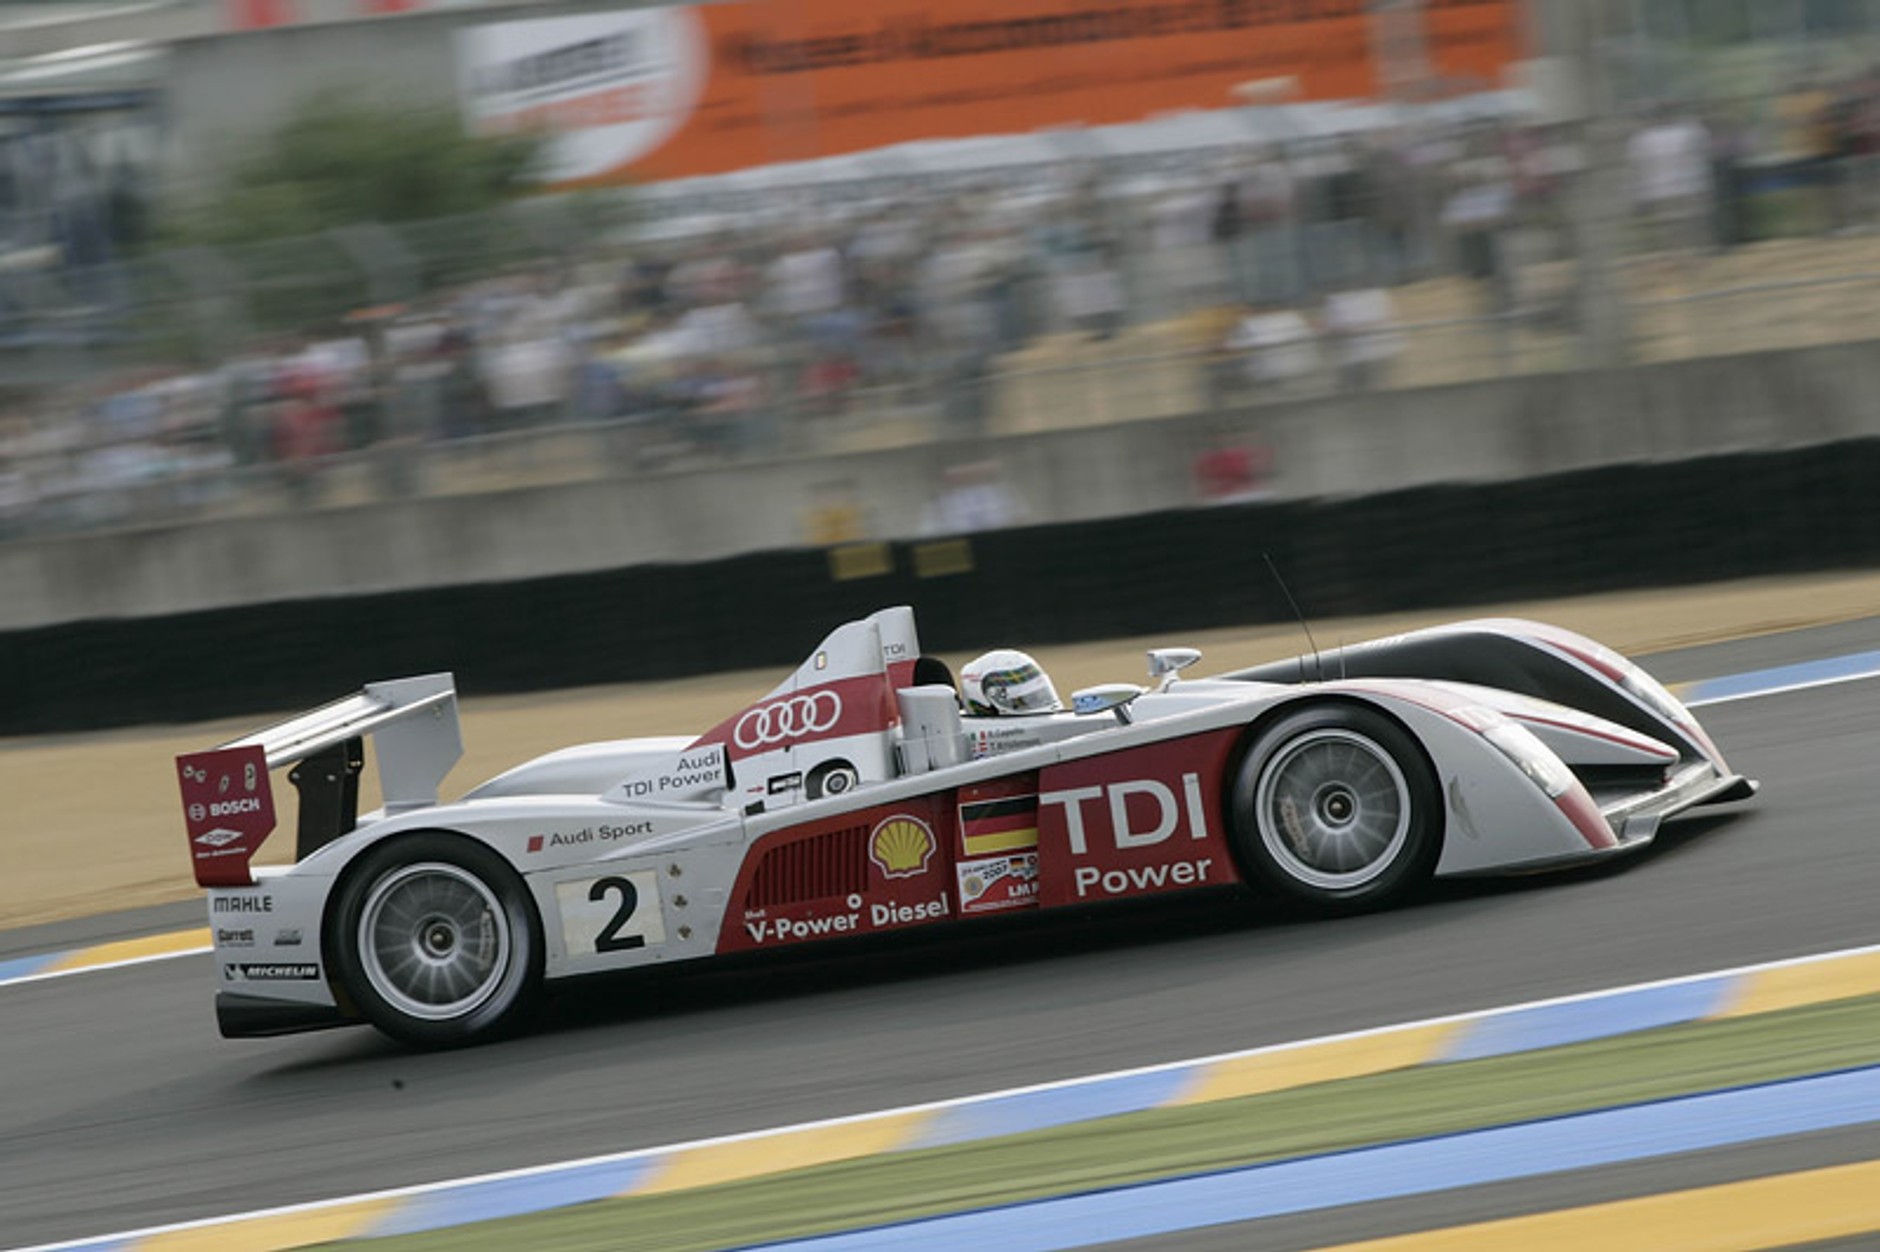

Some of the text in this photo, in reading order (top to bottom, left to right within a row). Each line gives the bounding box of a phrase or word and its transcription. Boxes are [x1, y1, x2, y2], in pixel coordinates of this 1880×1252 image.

[677, 751, 721, 771] Audi
[623, 768, 722, 797] TDI Power
[209, 798, 260, 816] BOSCH
[1039, 773, 1207, 854] TDI
[550, 821, 653, 846] Audi Sport
[1075, 859, 1212, 897] Power
[214, 895, 272, 912] MAHLE
[589, 876, 646, 953] 2
[748, 914, 859, 943] V-Power
[871, 892, 949, 926] Diesel
[247, 966, 317, 977] MICHELIN
